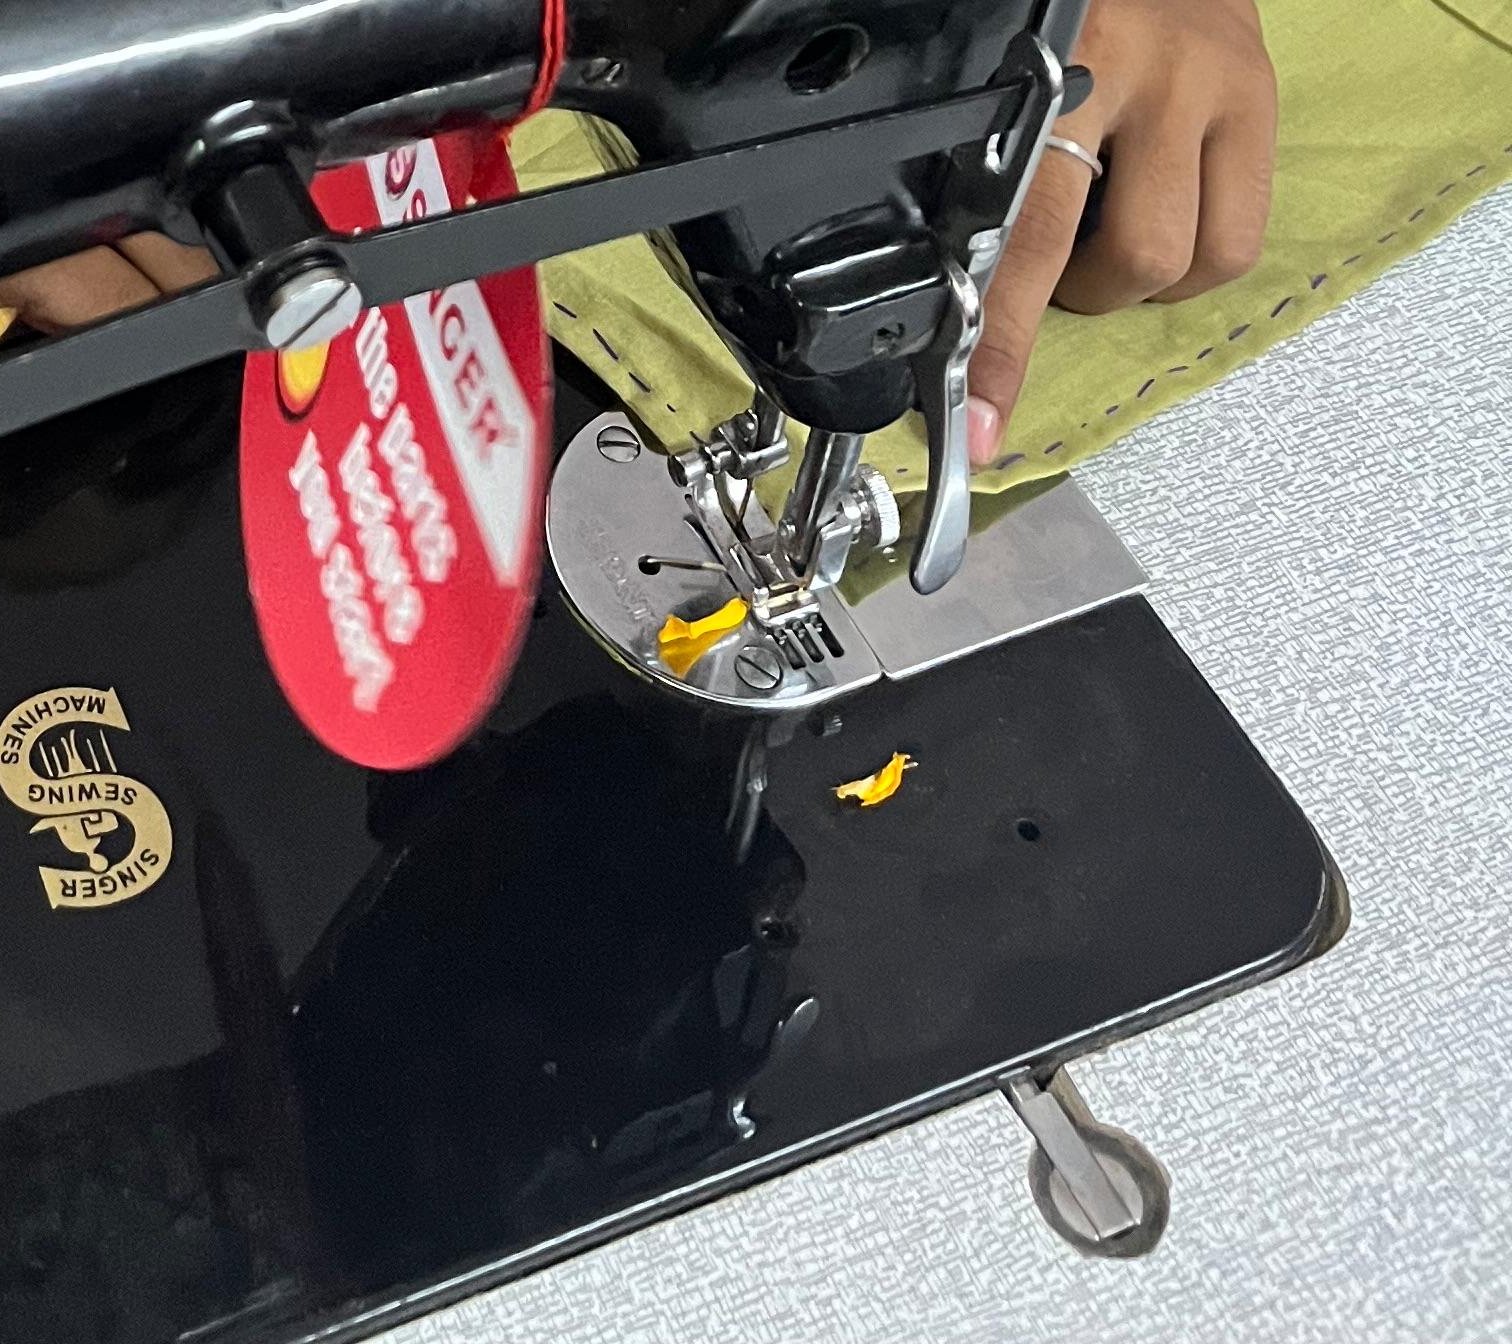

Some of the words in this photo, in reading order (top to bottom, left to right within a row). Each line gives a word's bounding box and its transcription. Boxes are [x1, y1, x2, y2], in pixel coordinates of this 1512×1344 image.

[0, 694, 106, 766] MACHINES
[28, 782, 138, 806] SEWING
[60, 848, 160, 899] SINGER
